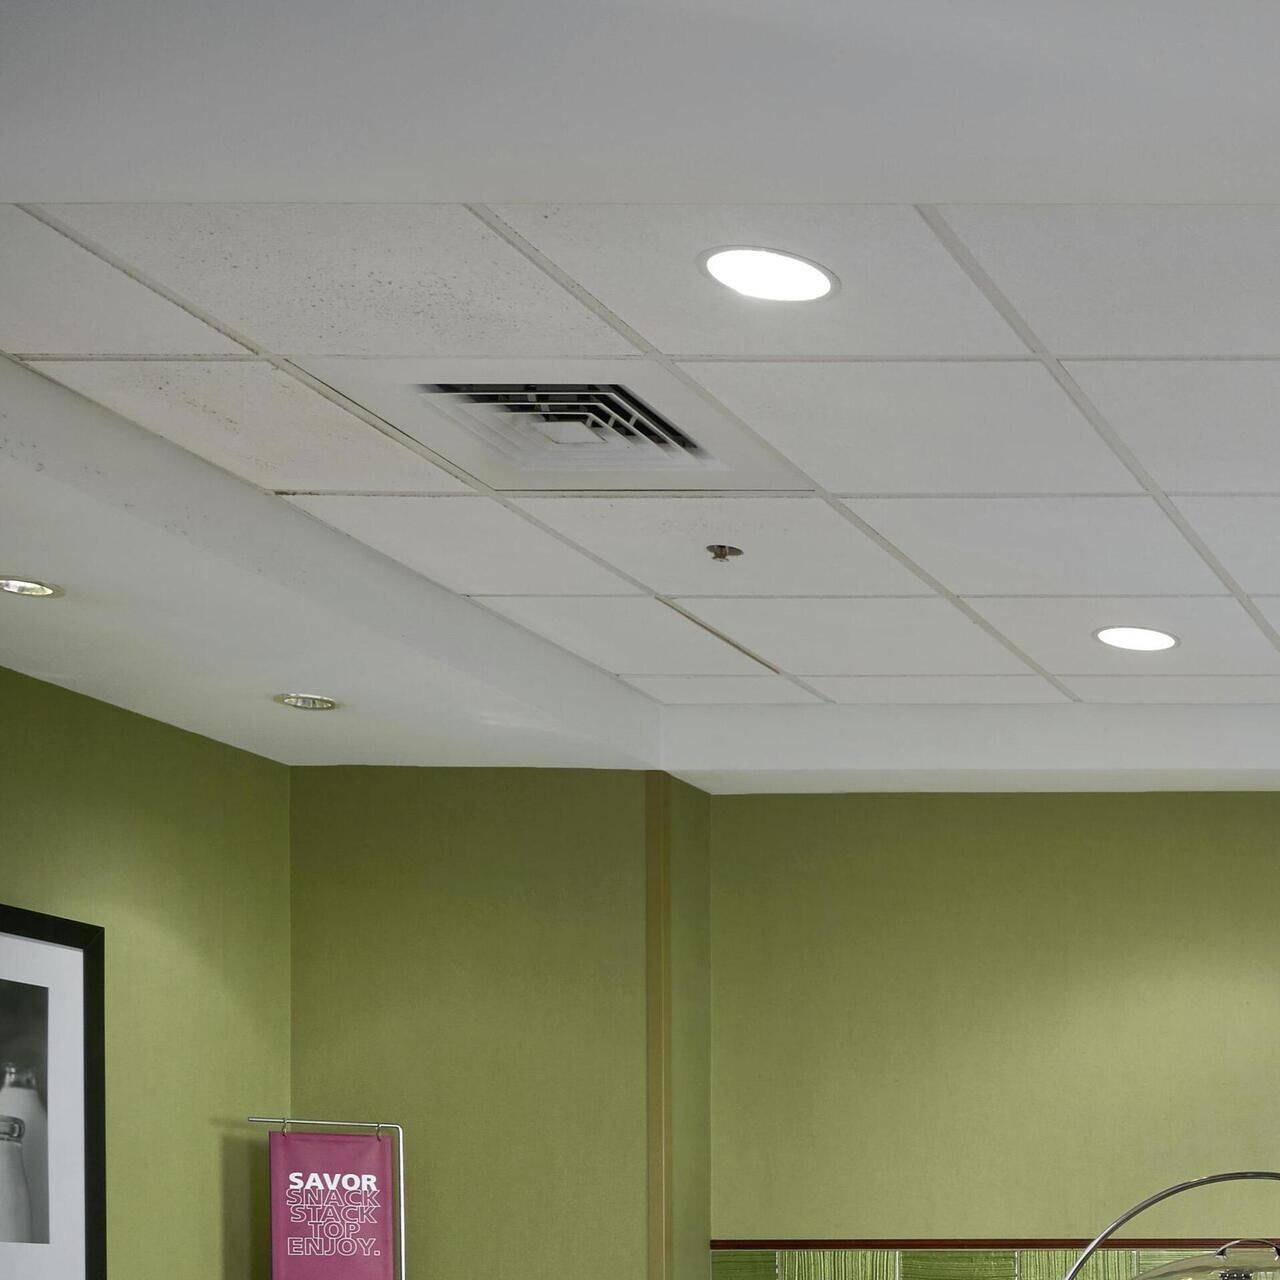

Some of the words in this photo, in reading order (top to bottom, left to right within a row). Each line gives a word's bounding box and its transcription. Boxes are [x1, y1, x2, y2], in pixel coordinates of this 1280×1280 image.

[288, 1172, 378, 1191] SAVOR
[286, 1188, 381, 1207] SNACK
[290, 1204, 377, 1223] STACK
[308, 1221, 360, 1239] TOP
[287, 1237, 381, 1256] ENJOY.
